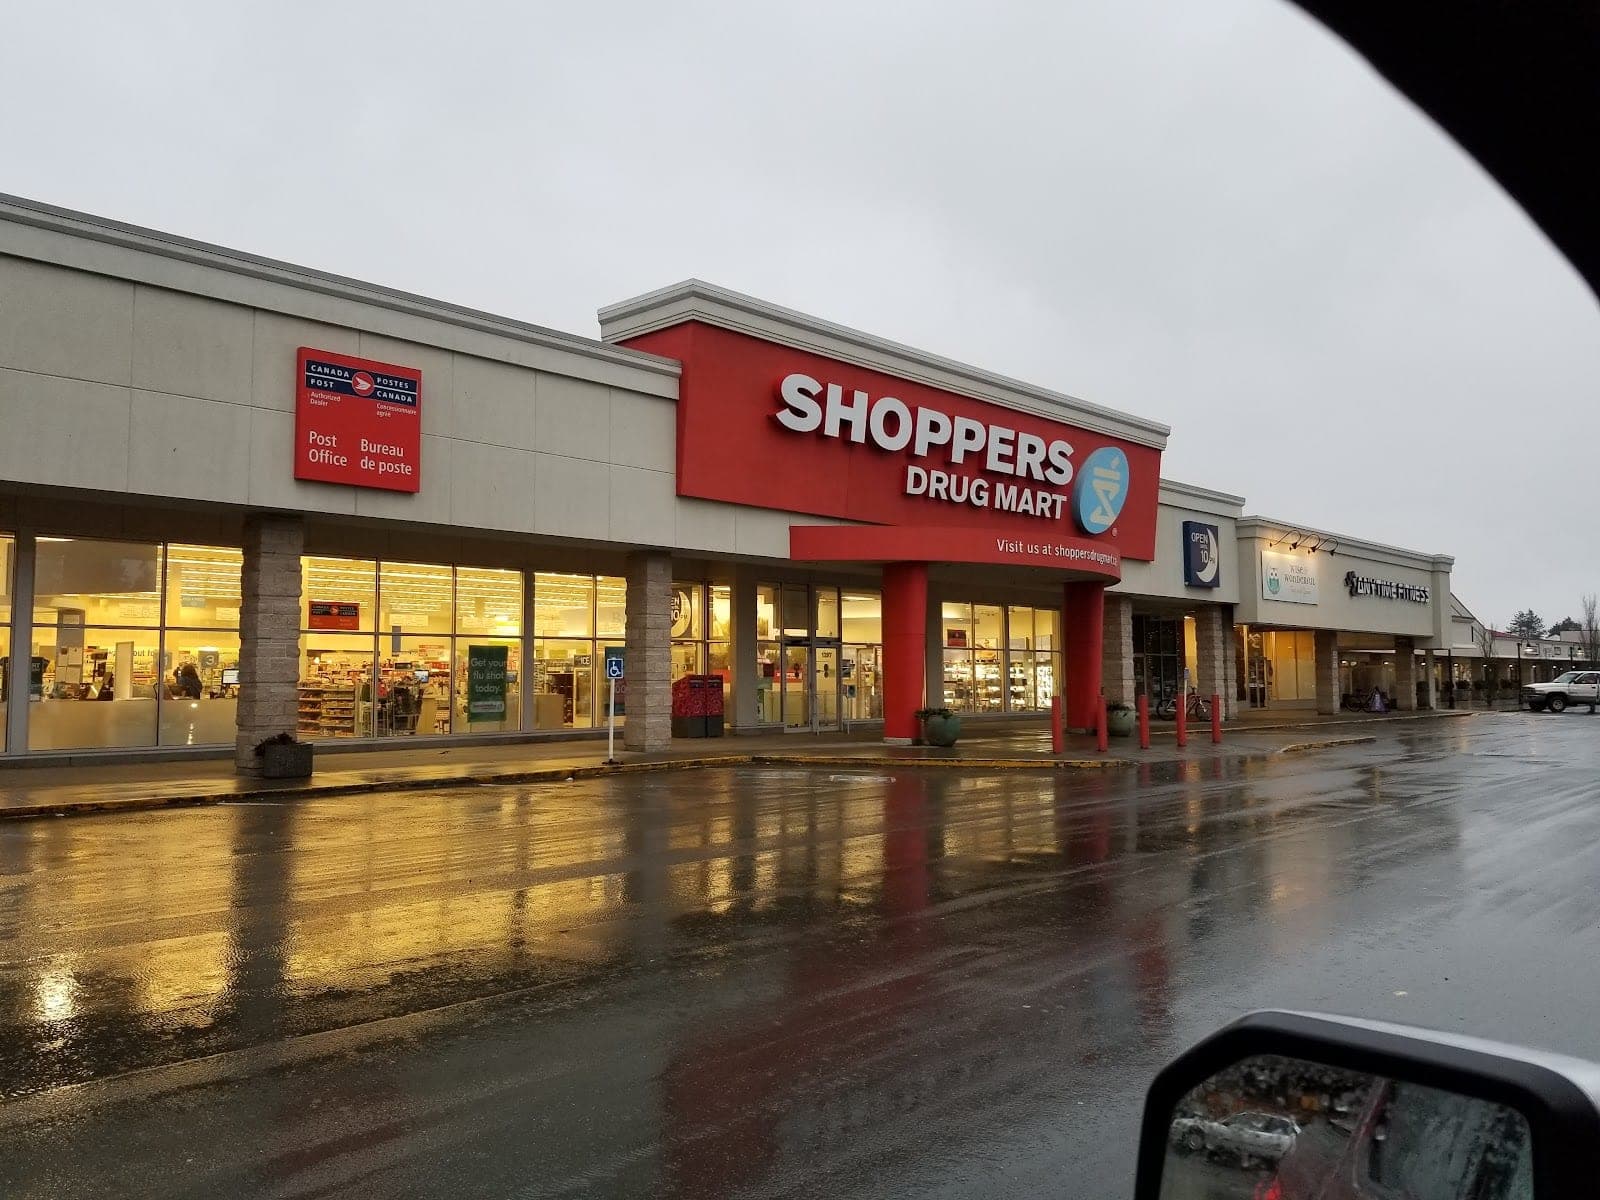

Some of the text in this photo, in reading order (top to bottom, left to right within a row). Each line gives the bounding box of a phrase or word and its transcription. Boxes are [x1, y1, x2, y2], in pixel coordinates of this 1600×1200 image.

[310, 364, 350, 378] CANADA
[310, 378, 334, 388] POST
[376, 377, 409, 389] POSTES
[310, 391, 341, 402] Authorized
[376, 390, 413, 402] CANADA
[775, 373, 1074, 486] SHOPPERS
[309, 431, 337, 448] Post
[360, 438, 404, 457] Bureau
[308, 449, 348, 467] Office
[360, 456, 412, 475] de poste
[905, 465, 1067, 520] DRUG MART
[1191, 532, 1208, 544] OPEN
[996, 538, 1024, 553] Visit
[1027, 543, 1039, 554] us
[1042, 544, 1052, 555] at
[1200, 550, 1209, 563] 10
[1356, 576, 1431, 604] ANYTIME FITNESS
[206, 655, 215, 665] 3
[471, 657, 486, 667] Get
[473, 670, 504, 680] flu shot
